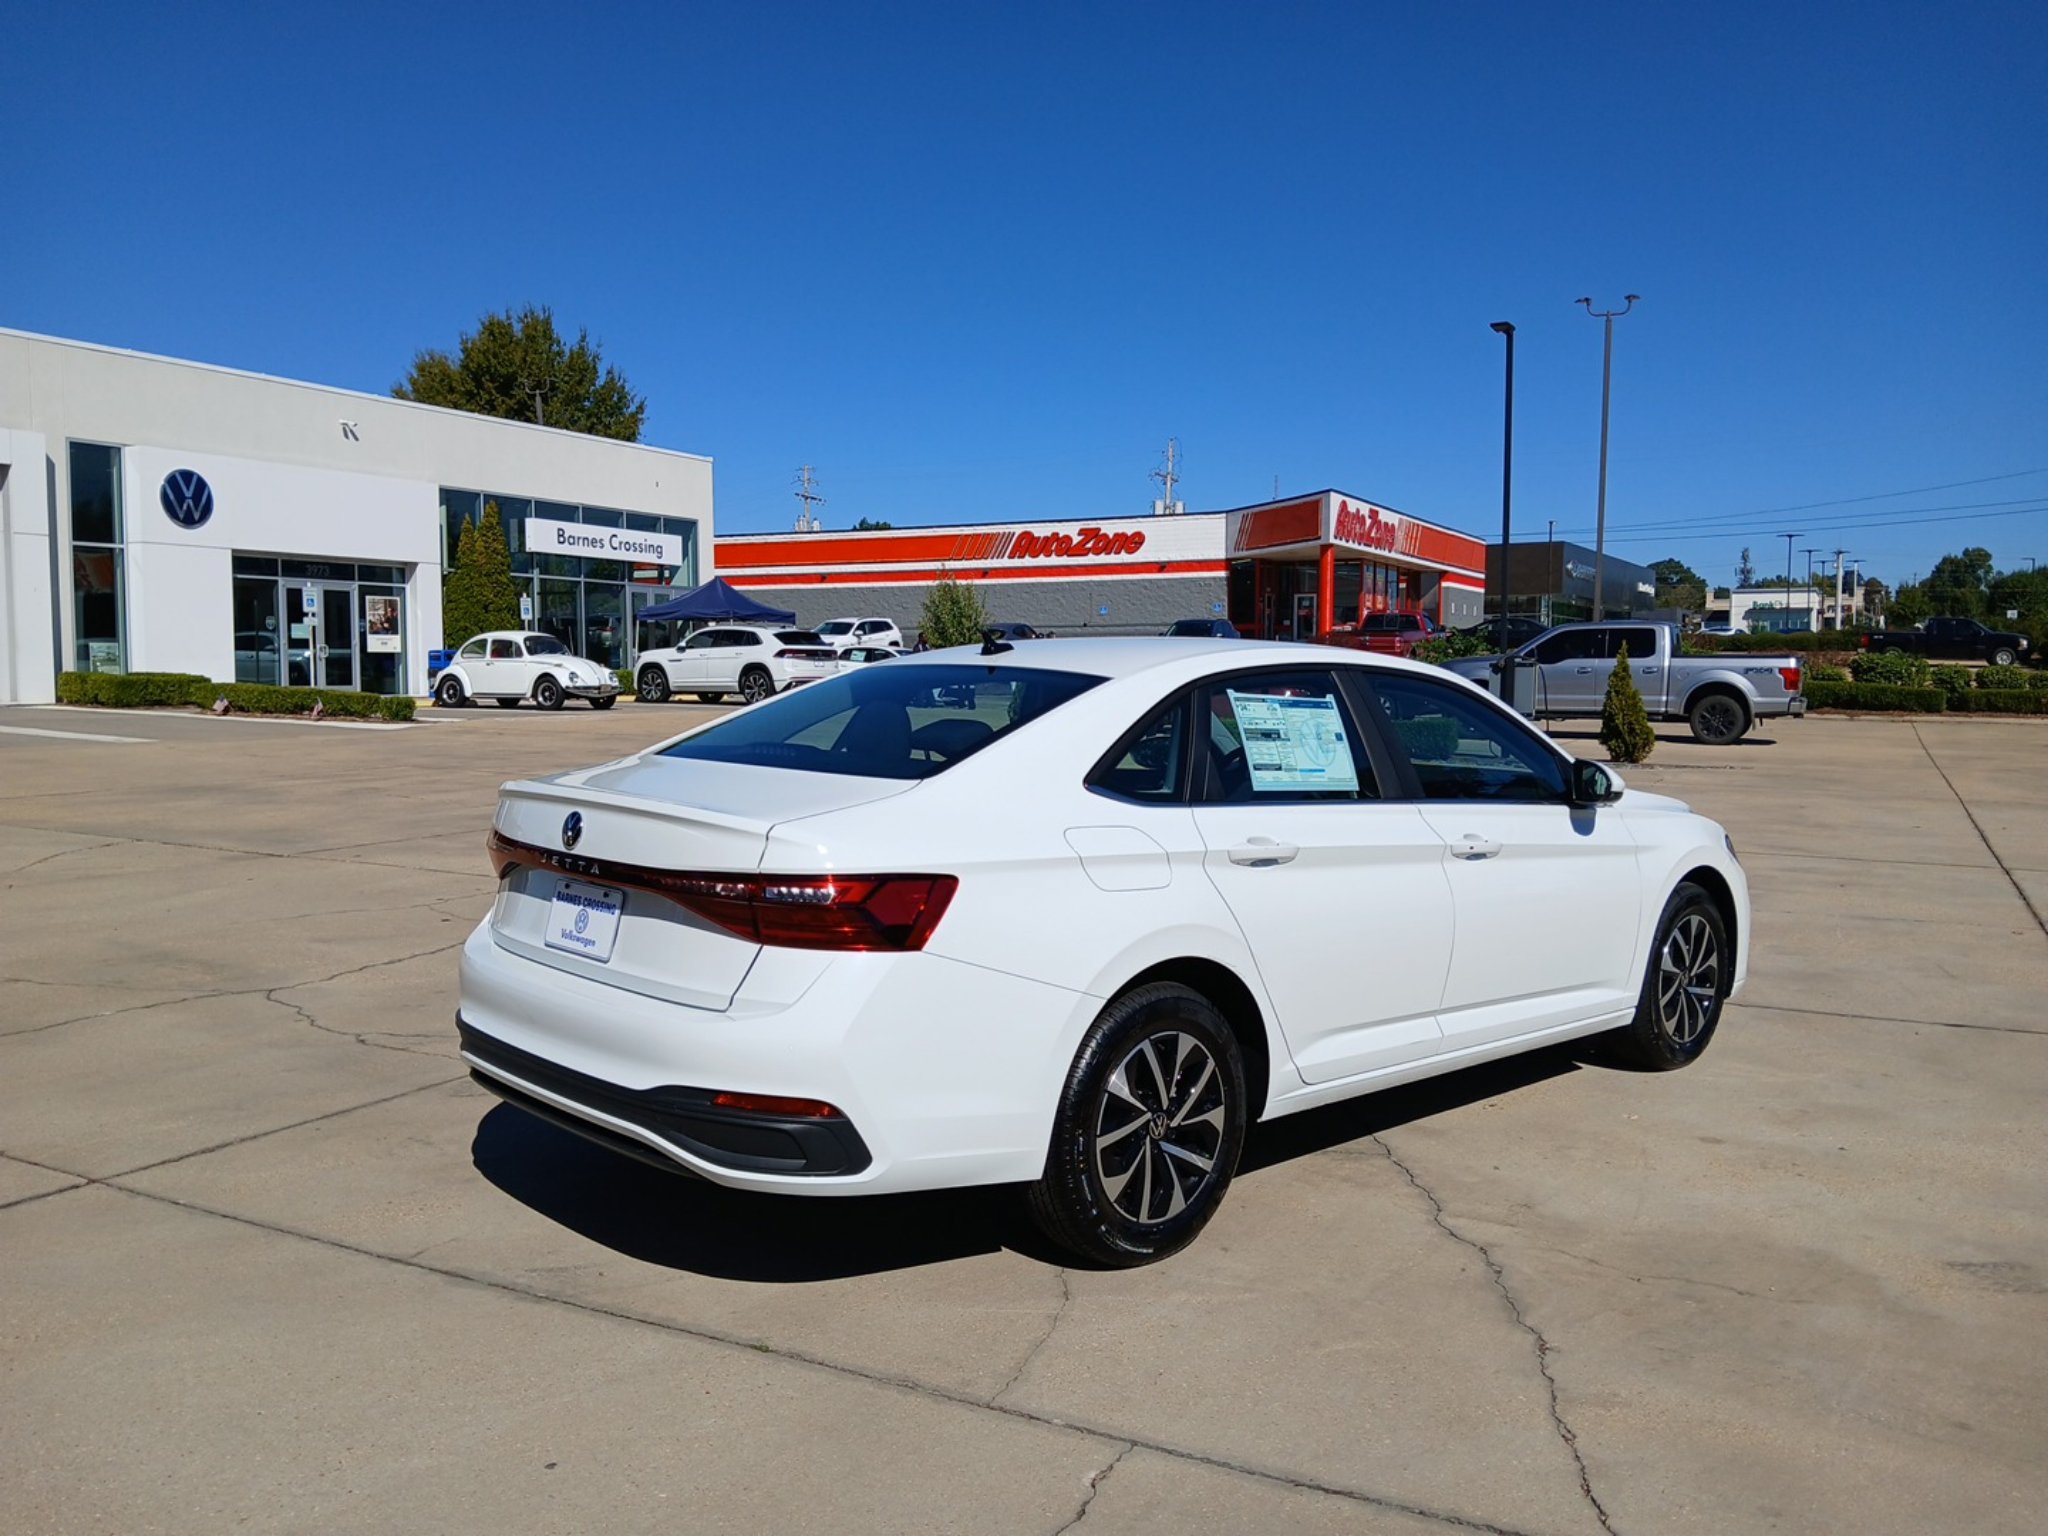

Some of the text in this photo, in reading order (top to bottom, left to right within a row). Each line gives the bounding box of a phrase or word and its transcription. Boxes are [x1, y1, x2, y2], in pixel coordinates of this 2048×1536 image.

[1334, 499, 1396, 553] AutoZone
[556, 527, 664, 559] Barnes Crossing
[1007, 527, 1146, 559] AutoZone
[540, 854, 600, 874] JETTA
[556, 890, 617, 915] BARNES CROSSING
[561, 928, 596, 948] Volkswagen
